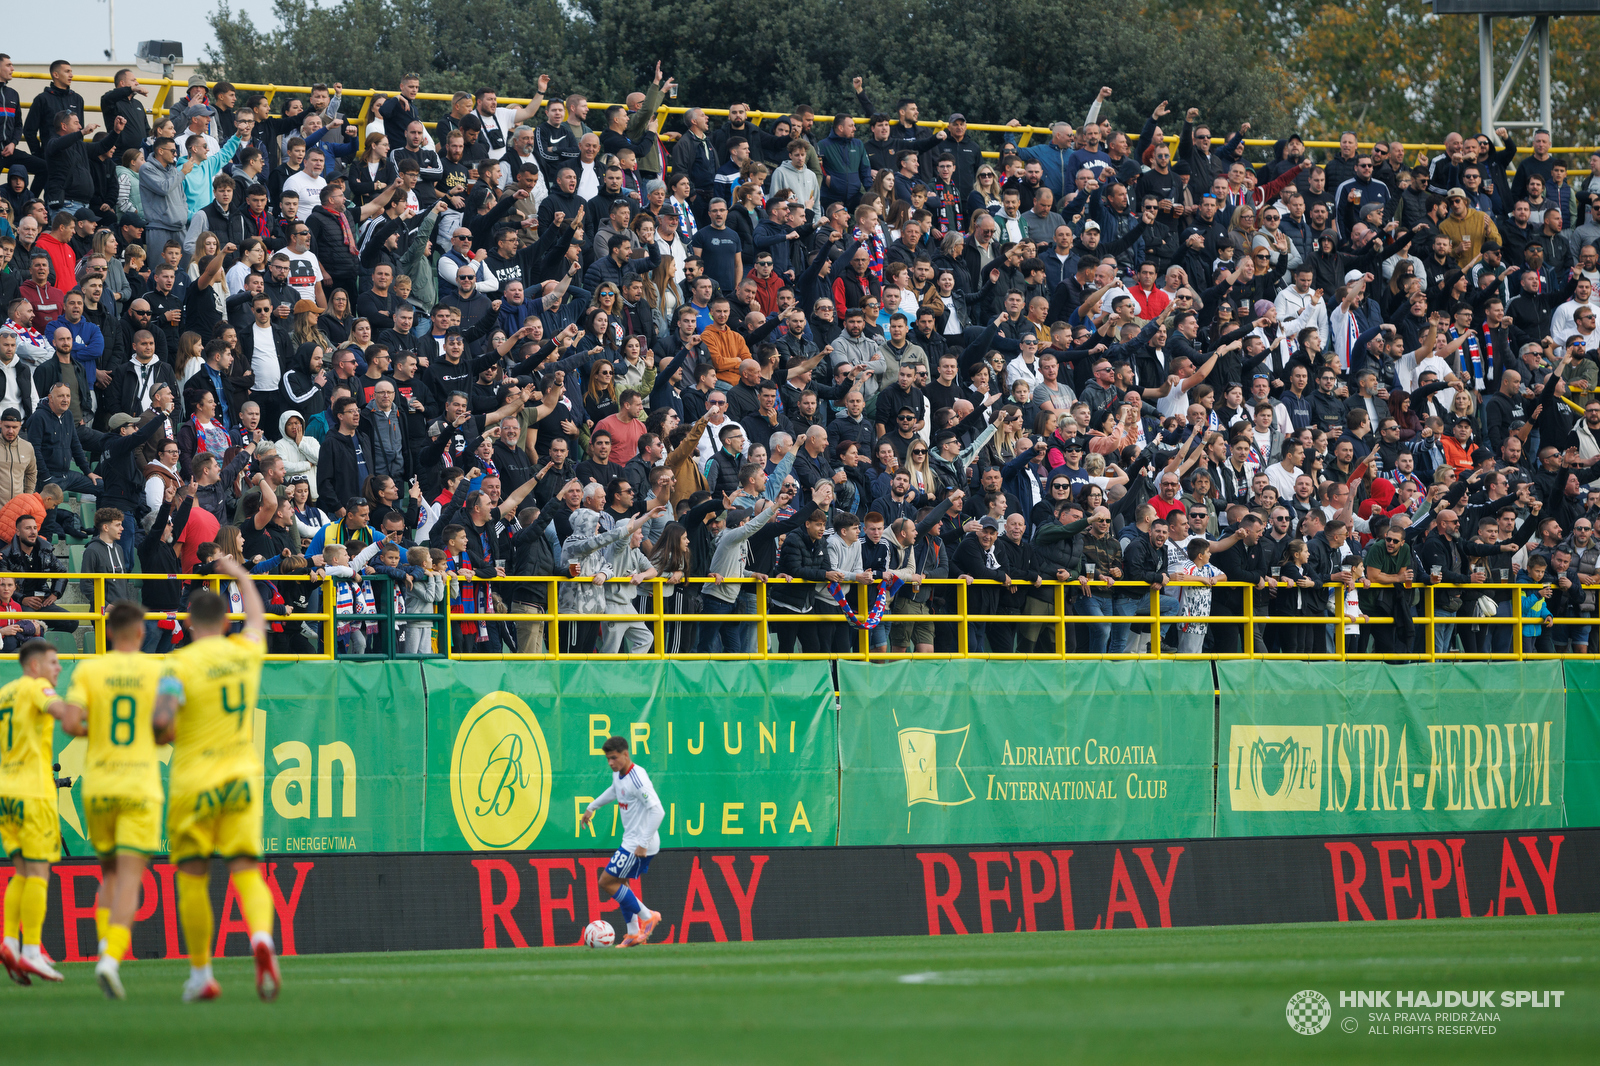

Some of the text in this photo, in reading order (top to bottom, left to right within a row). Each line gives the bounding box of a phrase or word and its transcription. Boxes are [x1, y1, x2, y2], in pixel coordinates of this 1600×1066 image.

[110, 693, 137, 747] 8
[221, 682, 247, 735] 4
[589, 713, 796, 756] BRIJUNI
[1001, 738, 1158, 766] ADRIATIC CROATIA
[985, 772, 1168, 801] INTERNATIONAL CLUB
[1325, 721, 1553, 813] ISTRA-FERRUM
[574, 796, 813, 838] RIIJERA
[286, 836, 357, 851] ENERGENTIMA
[610, 850, 628, 868] 38
[916, 847, 1185, 936] REPLAY
[1324, 835, 1566, 922] REPLAY
